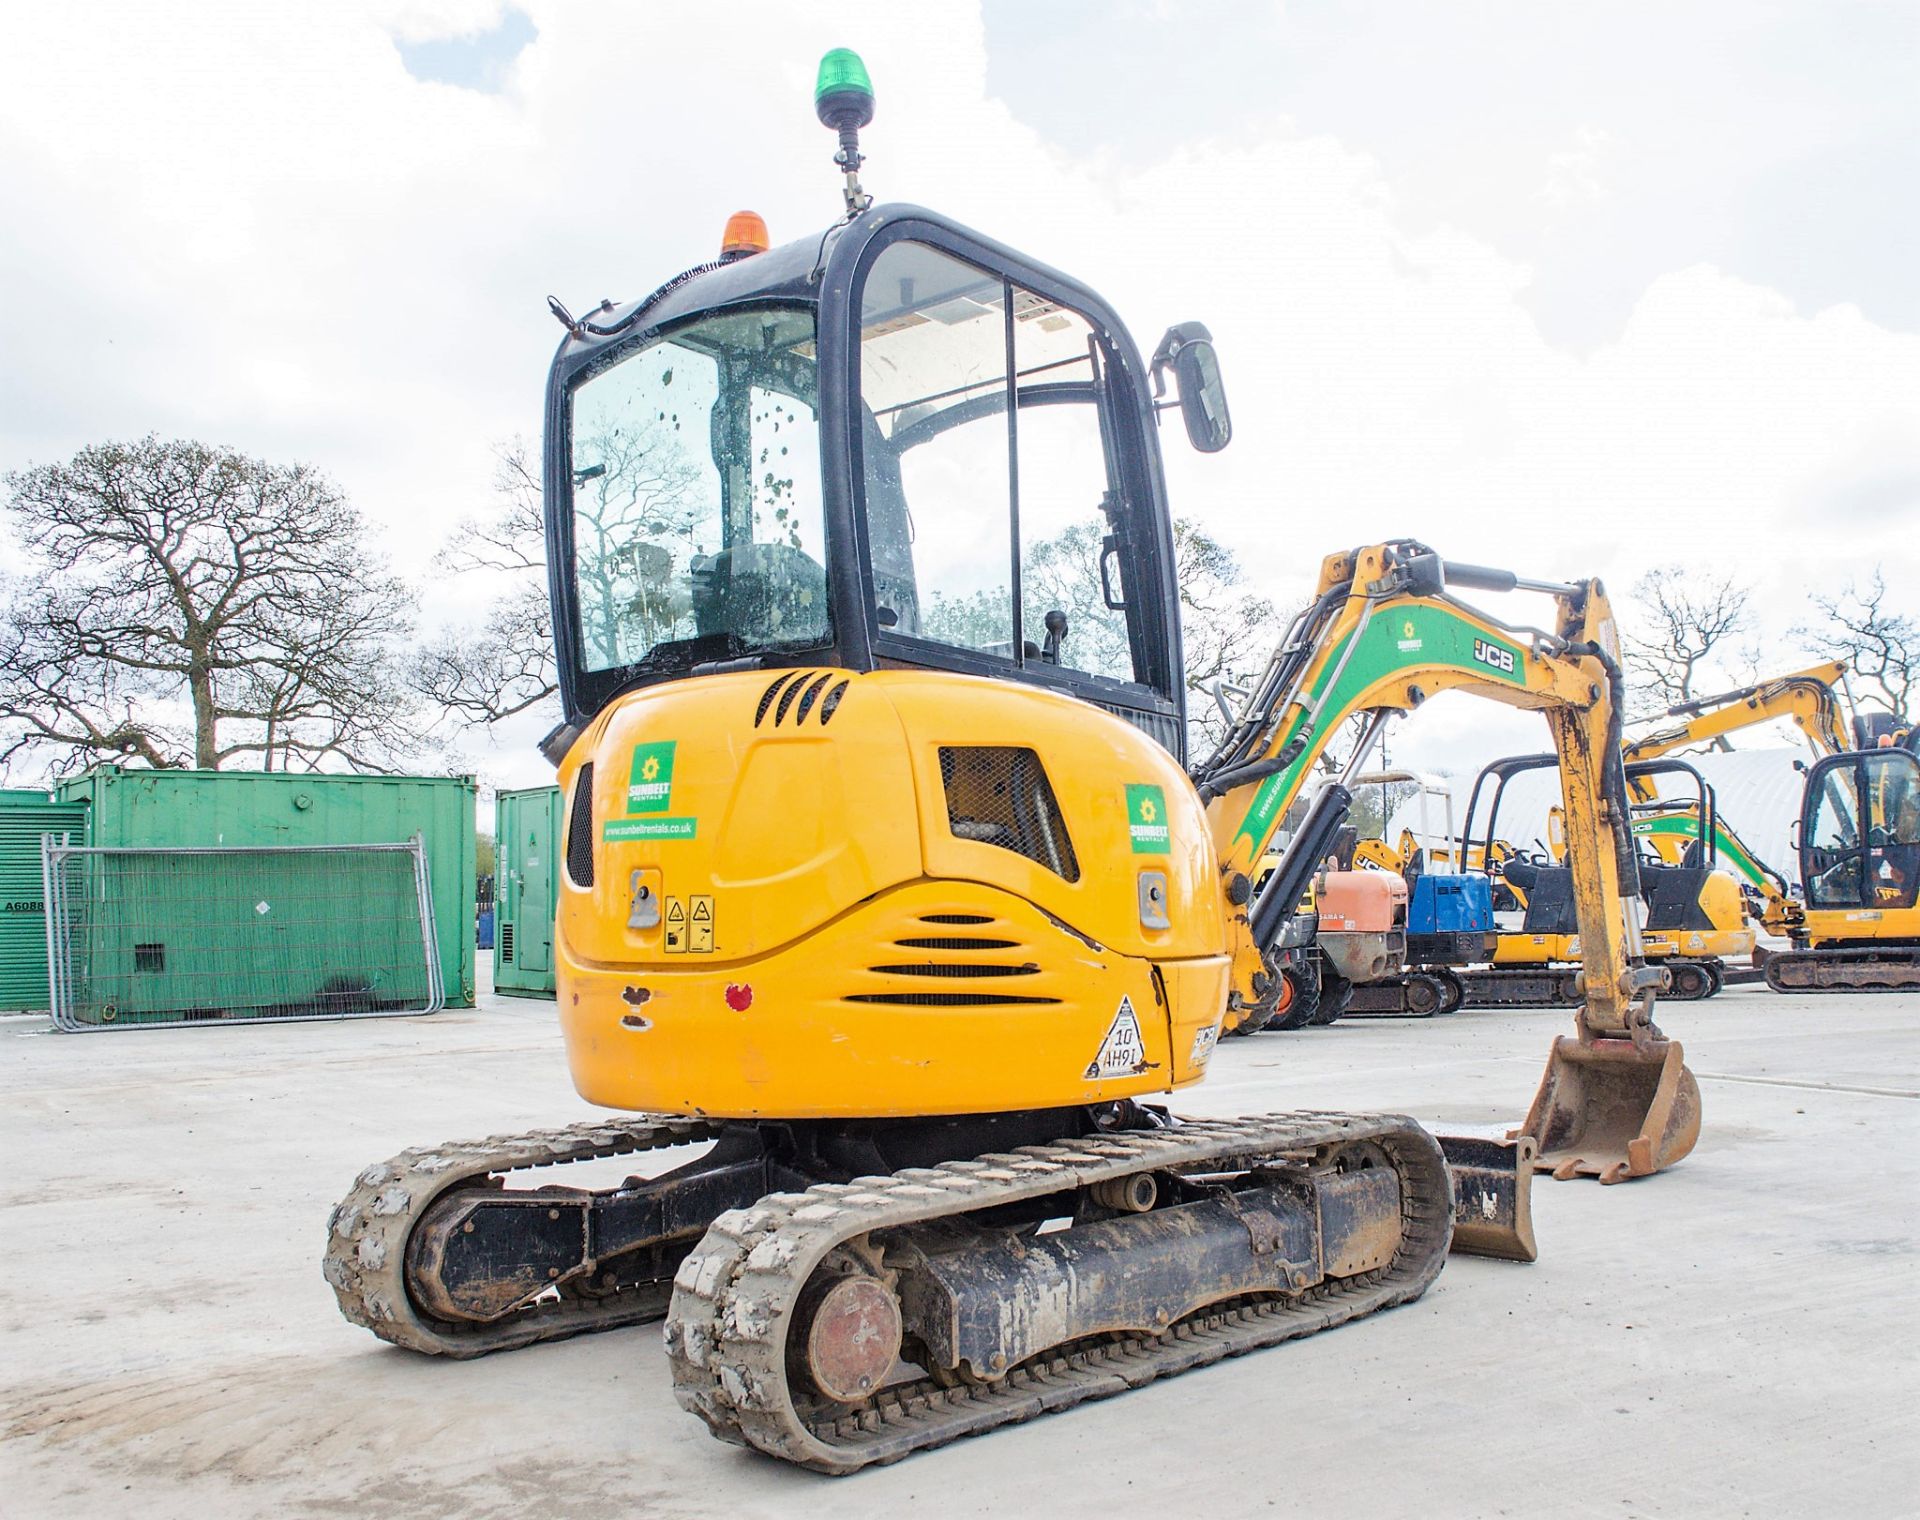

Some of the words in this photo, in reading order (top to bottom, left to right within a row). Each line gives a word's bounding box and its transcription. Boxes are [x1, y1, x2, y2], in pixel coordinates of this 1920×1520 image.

[1474, 640, 1514, 673] JCB
[629, 782, 670, 796] SUNBELT
[605, 823, 691, 836] www.sunbeltrentals.co.uk
[1130, 824, 1169, 838] SUNBELT
[1115, 1028, 1133, 1046] 10
